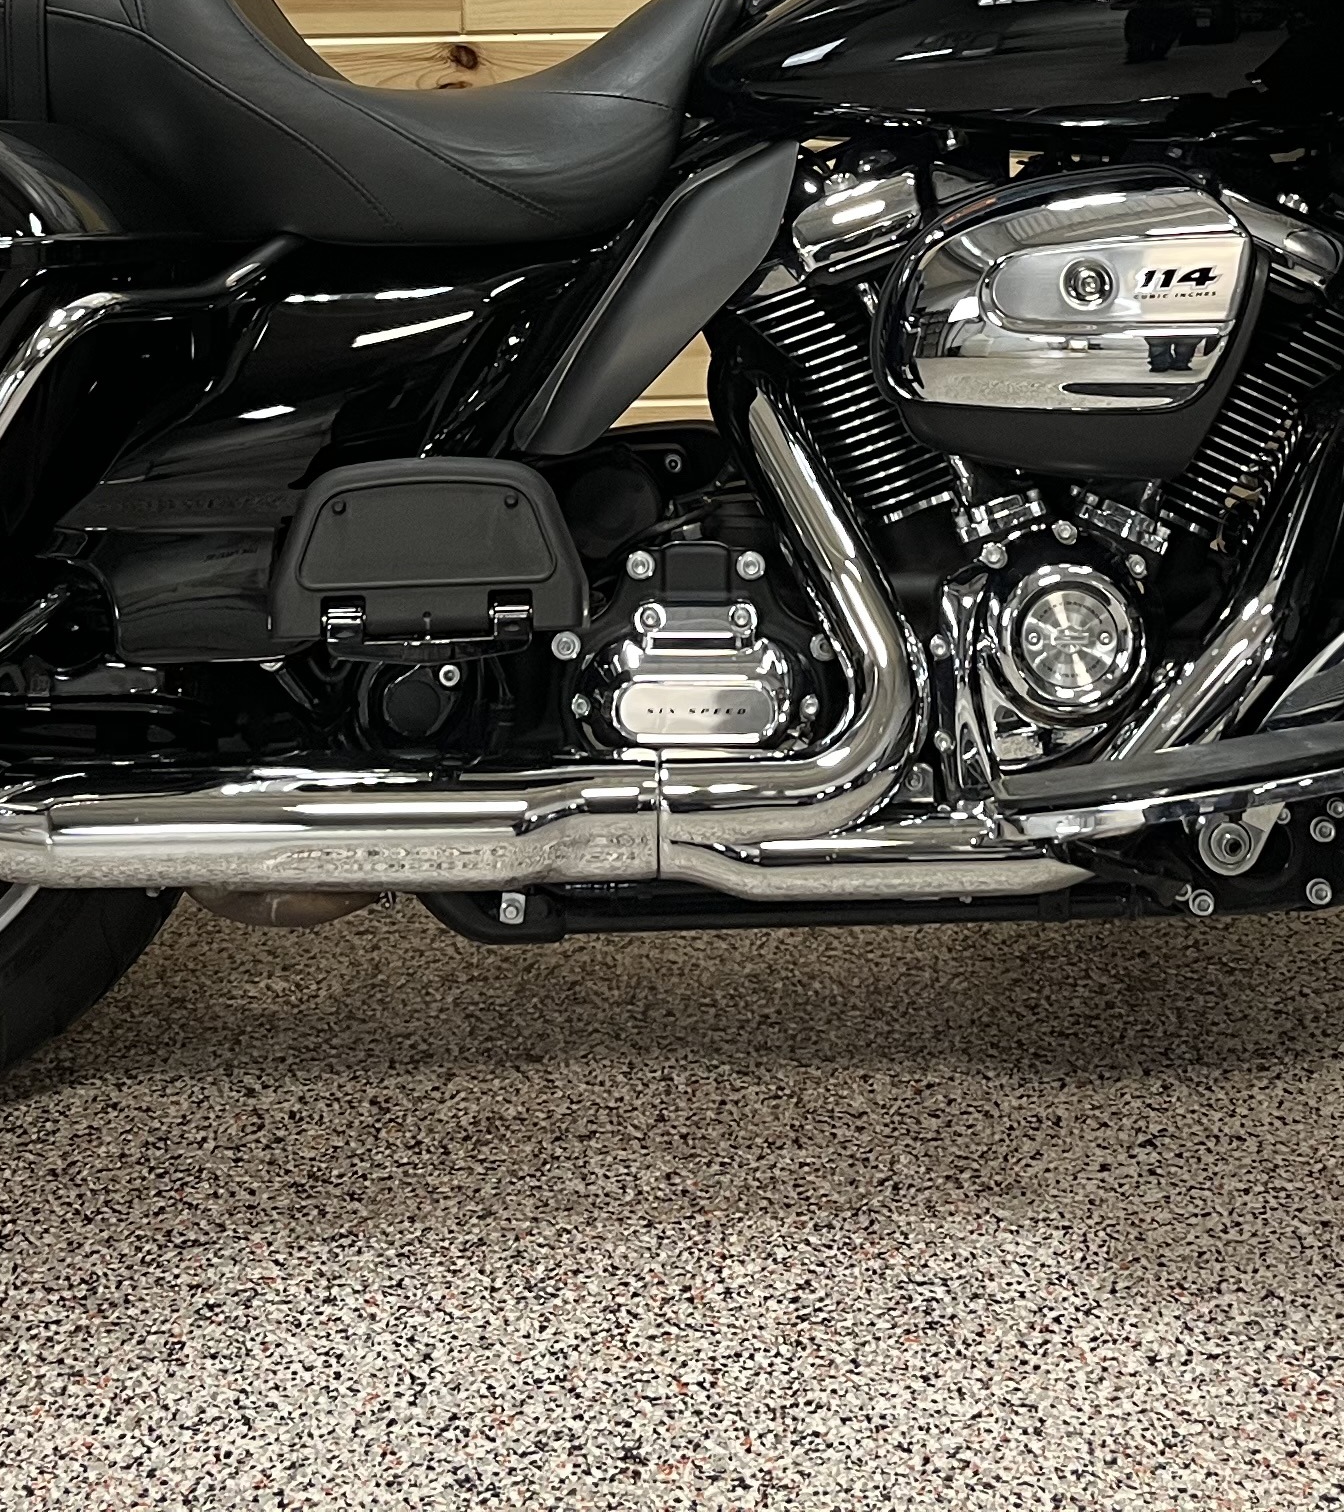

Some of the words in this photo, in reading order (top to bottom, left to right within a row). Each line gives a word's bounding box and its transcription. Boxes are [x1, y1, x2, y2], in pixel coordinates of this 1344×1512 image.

[1138, 266, 1220, 290] 114
[1133, 292, 1169, 300] CUBIC
[646, 707, 676, 715] SIX
[688, 707, 747, 715] SPEED
